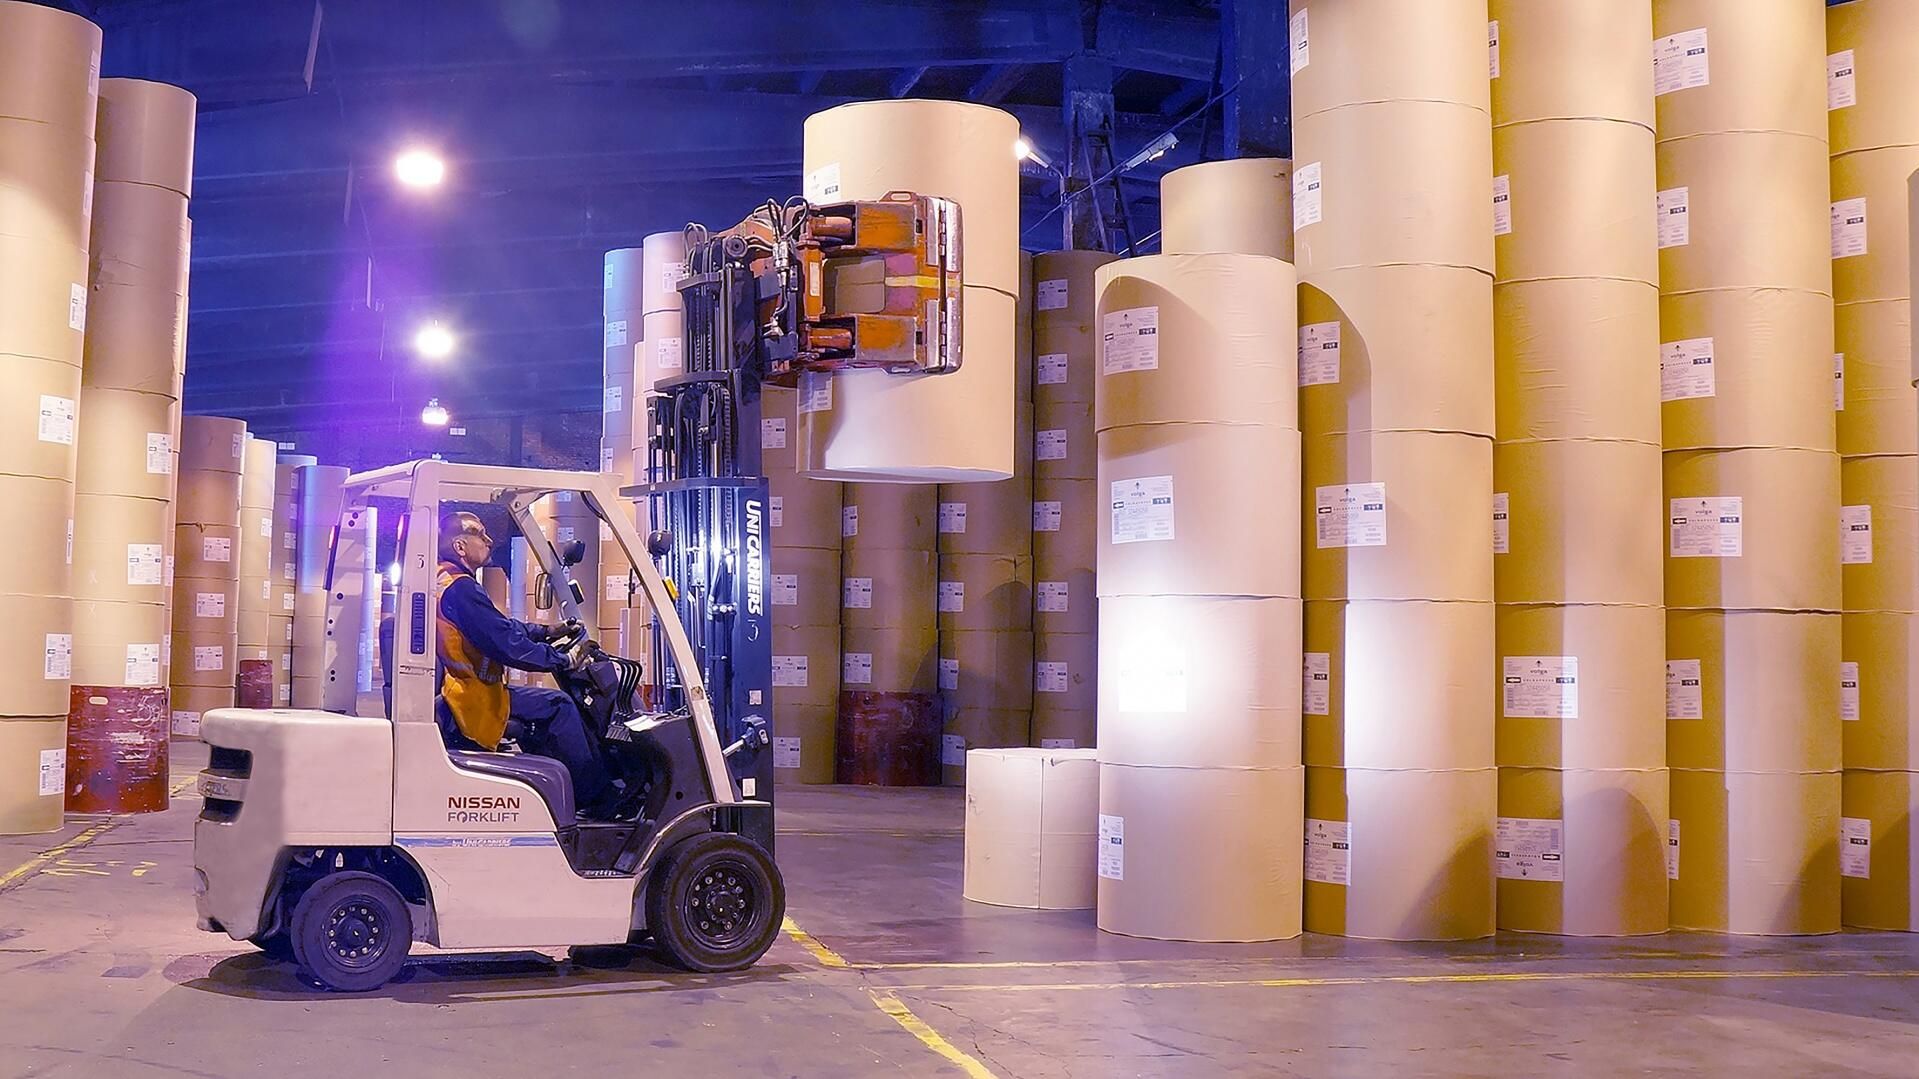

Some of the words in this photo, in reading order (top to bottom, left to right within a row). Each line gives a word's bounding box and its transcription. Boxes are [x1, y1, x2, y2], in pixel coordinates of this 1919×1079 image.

[746, 500, 764, 617] UNICARRIERS
[448, 797, 520, 809] NISSAN
[447, 811, 520, 823] FORKLIFT
